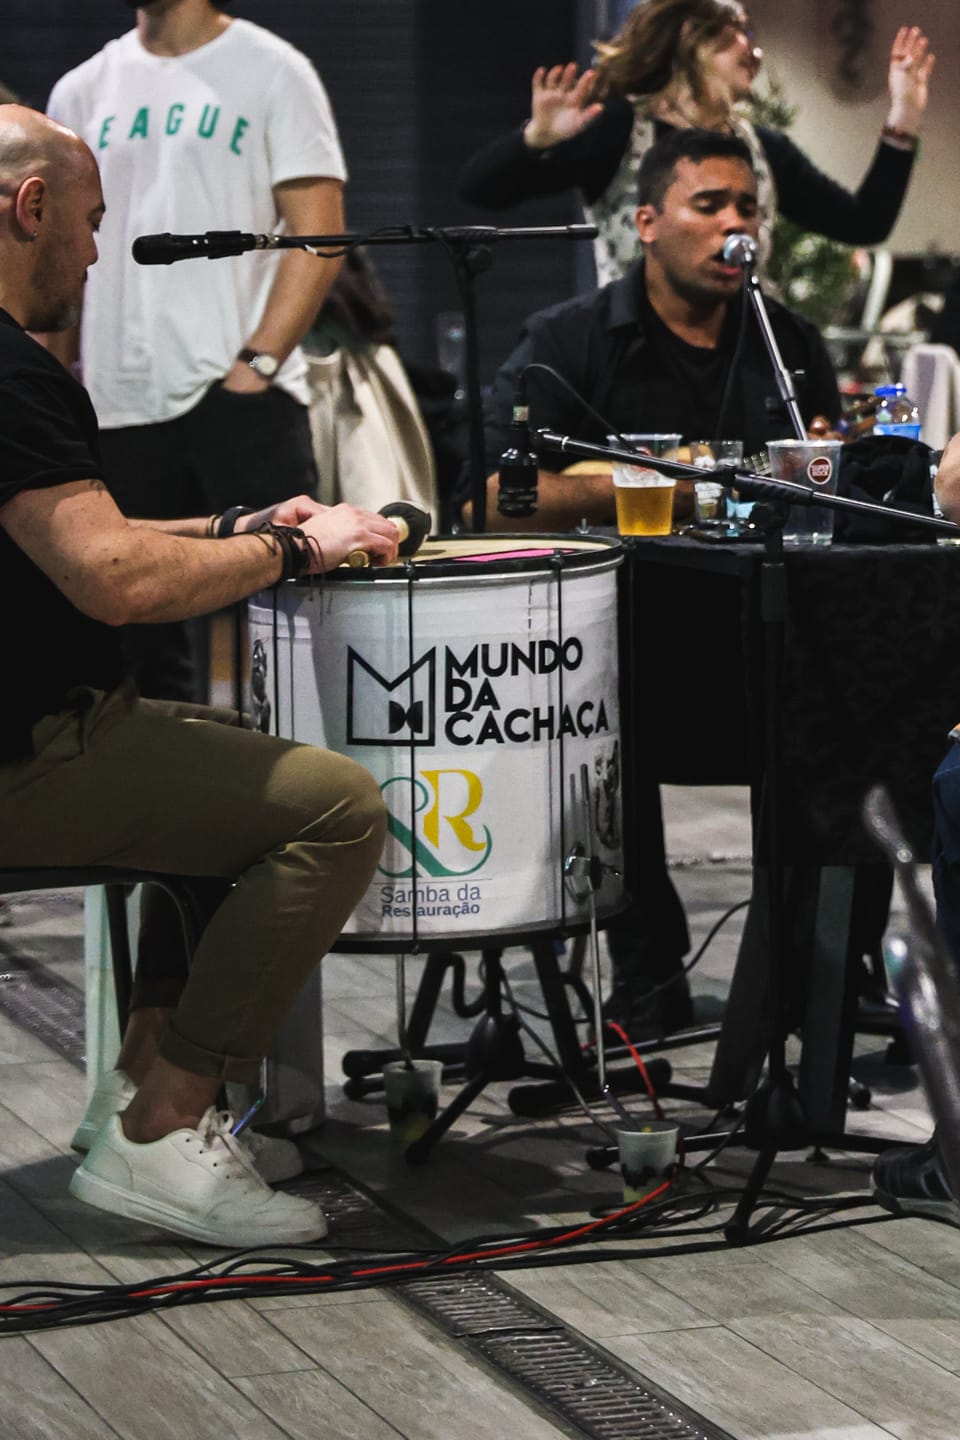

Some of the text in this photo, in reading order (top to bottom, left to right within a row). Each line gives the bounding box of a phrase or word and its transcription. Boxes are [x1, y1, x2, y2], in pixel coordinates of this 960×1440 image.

[99, 103, 249, 156] EAGUE
[445, 637, 583, 678] MUNDO
[445, 677, 501, 712] DA
[445, 698, 609, 746] CACHAÇA
[381, 883, 482, 903] Samba da
[382, 902, 481, 919] Resauração
